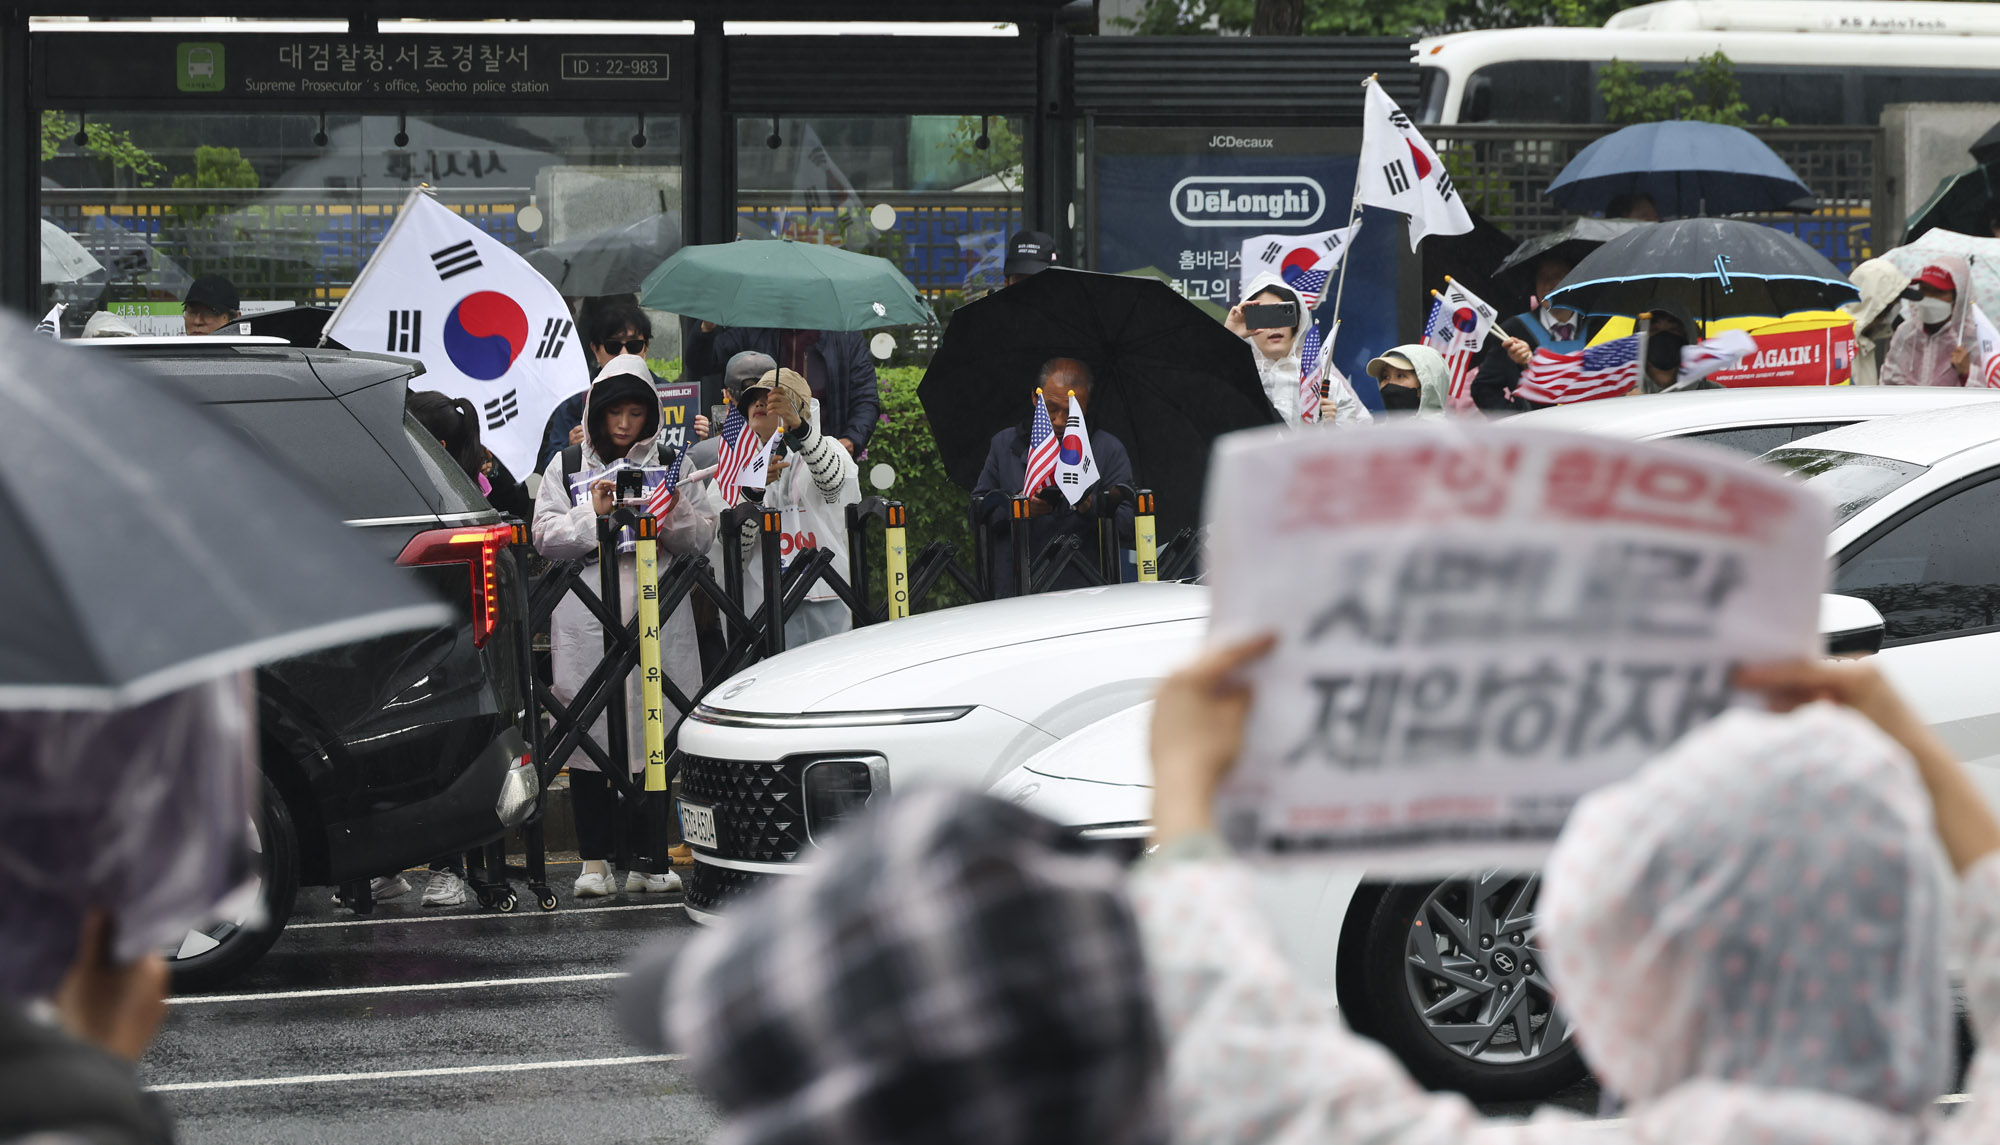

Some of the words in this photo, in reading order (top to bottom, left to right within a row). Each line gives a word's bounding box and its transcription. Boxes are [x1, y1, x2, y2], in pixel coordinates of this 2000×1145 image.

[279, 44, 529, 72] 대검찰청.서초경찰서
[573, 60, 590, 74] ID
[606, 60, 658, 75] 22-983
[245, 78, 296, 92] Supreme
[385, 79, 420, 93] office,
[425, 79, 467, 92] Seocho
[473, 79, 507, 94] police
[511, 80, 549, 92] station
[1208, 135, 1274, 149] JCDecaux
[1752, 345, 1811, 370] AGAIN
